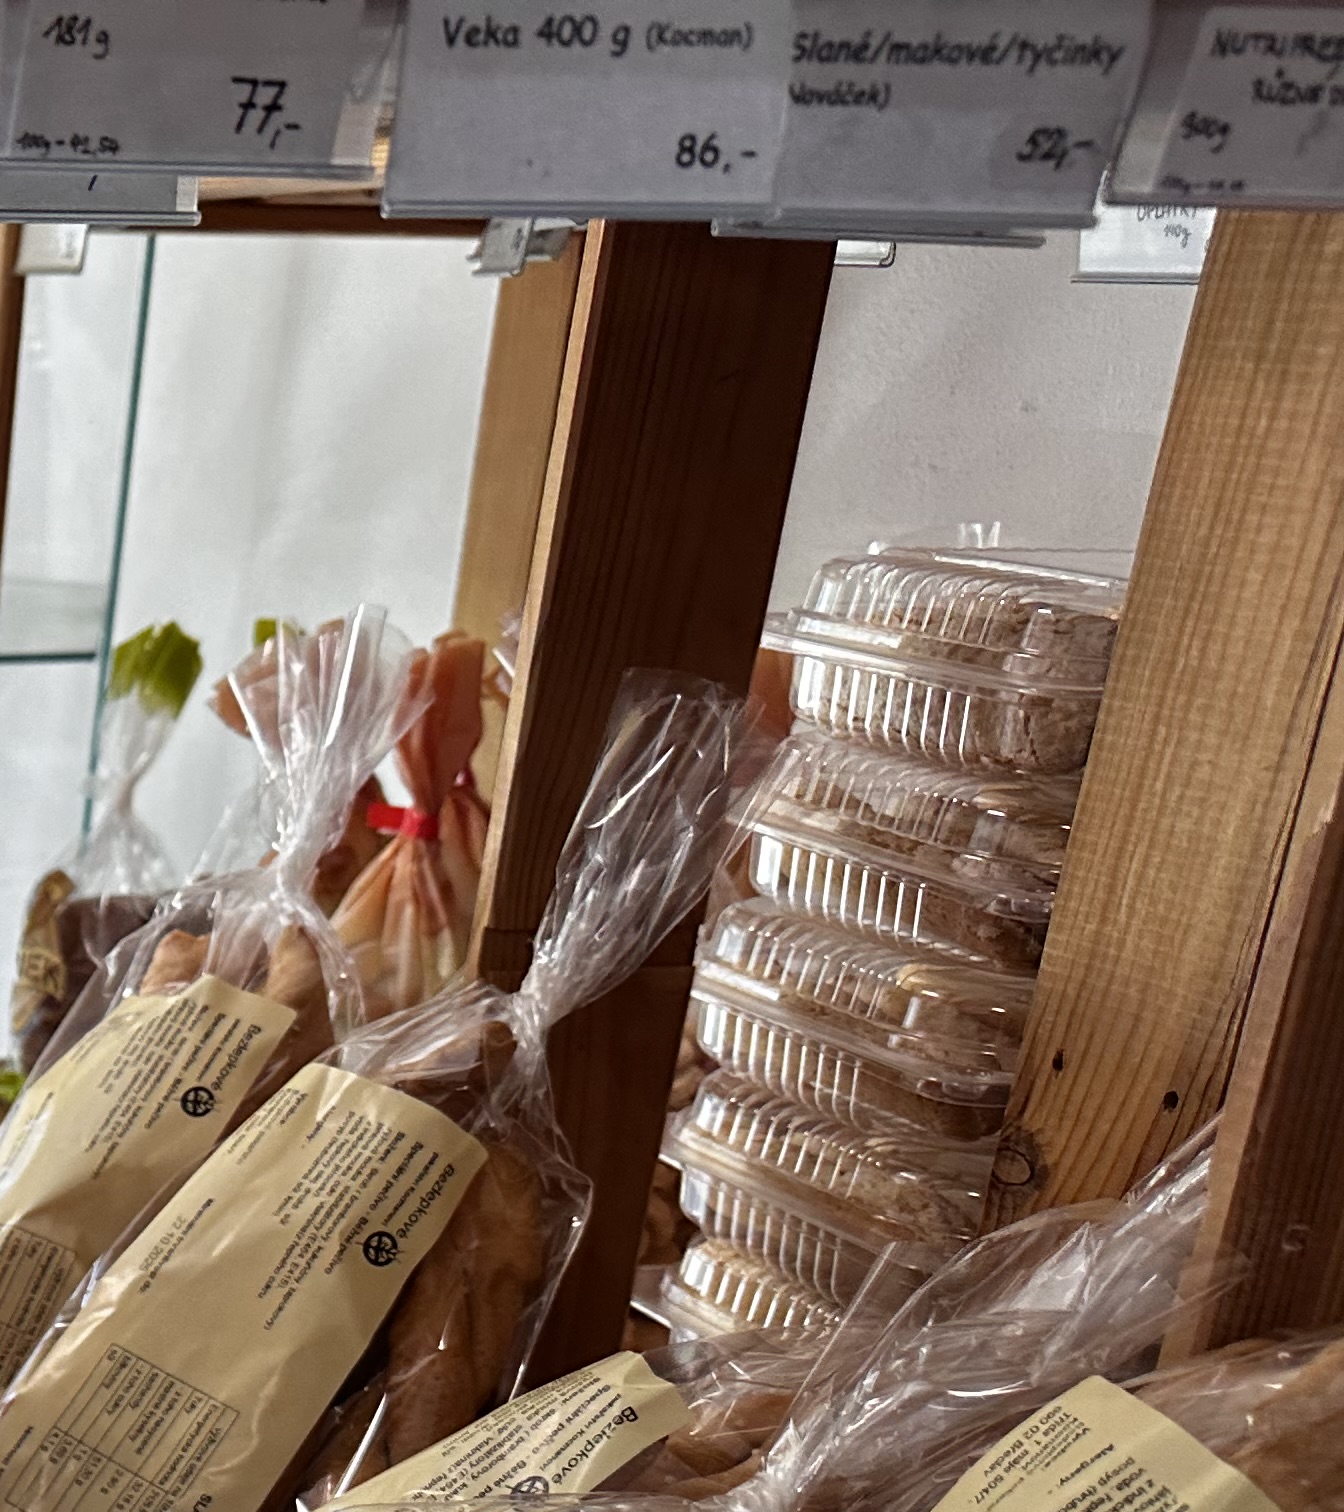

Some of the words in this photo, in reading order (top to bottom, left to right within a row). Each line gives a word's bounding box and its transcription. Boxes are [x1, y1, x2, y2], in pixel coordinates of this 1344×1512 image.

[443, 14, 521, 50] Veka
[535, 13, 601, 49] 400
[609, 24, 632, 59] g
[645, 21, 754, 53] (Kocman)
[231, 75, 303, 151] 77,-
[675, 131, 759, 175] 86,-
[393, 1159, 459, 1244] Bezlepkové
